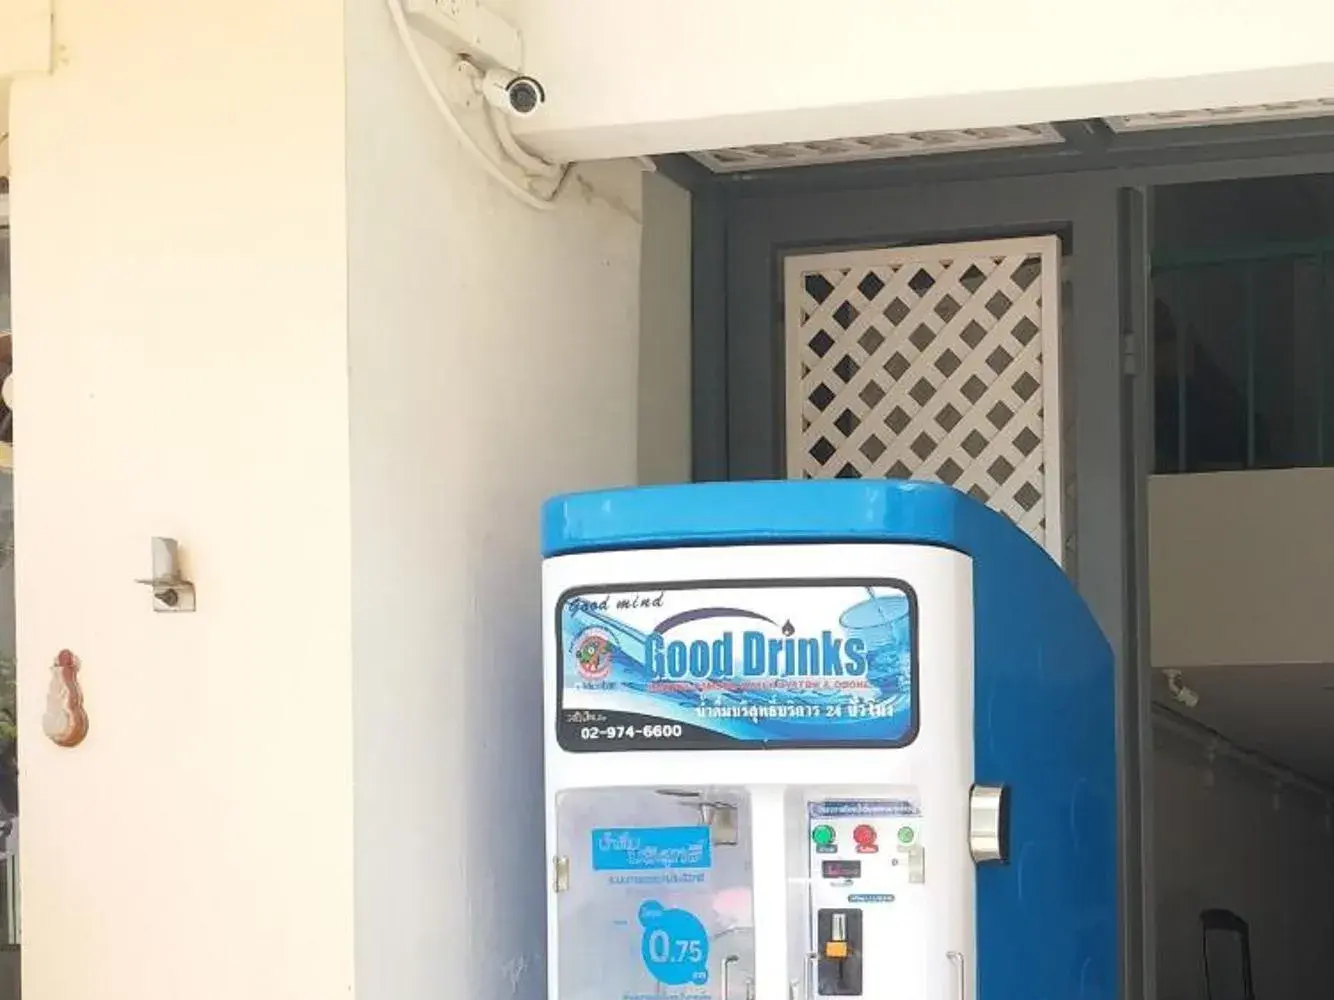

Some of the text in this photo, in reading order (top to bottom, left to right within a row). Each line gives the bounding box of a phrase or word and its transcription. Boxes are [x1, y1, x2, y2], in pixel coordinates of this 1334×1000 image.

[616, 591, 665, 609] mind
[645, 622, 868, 679] Good Drinks
[581, 724, 682, 740] 02-974-6600
[648, 929, 703, 963] 0.75
